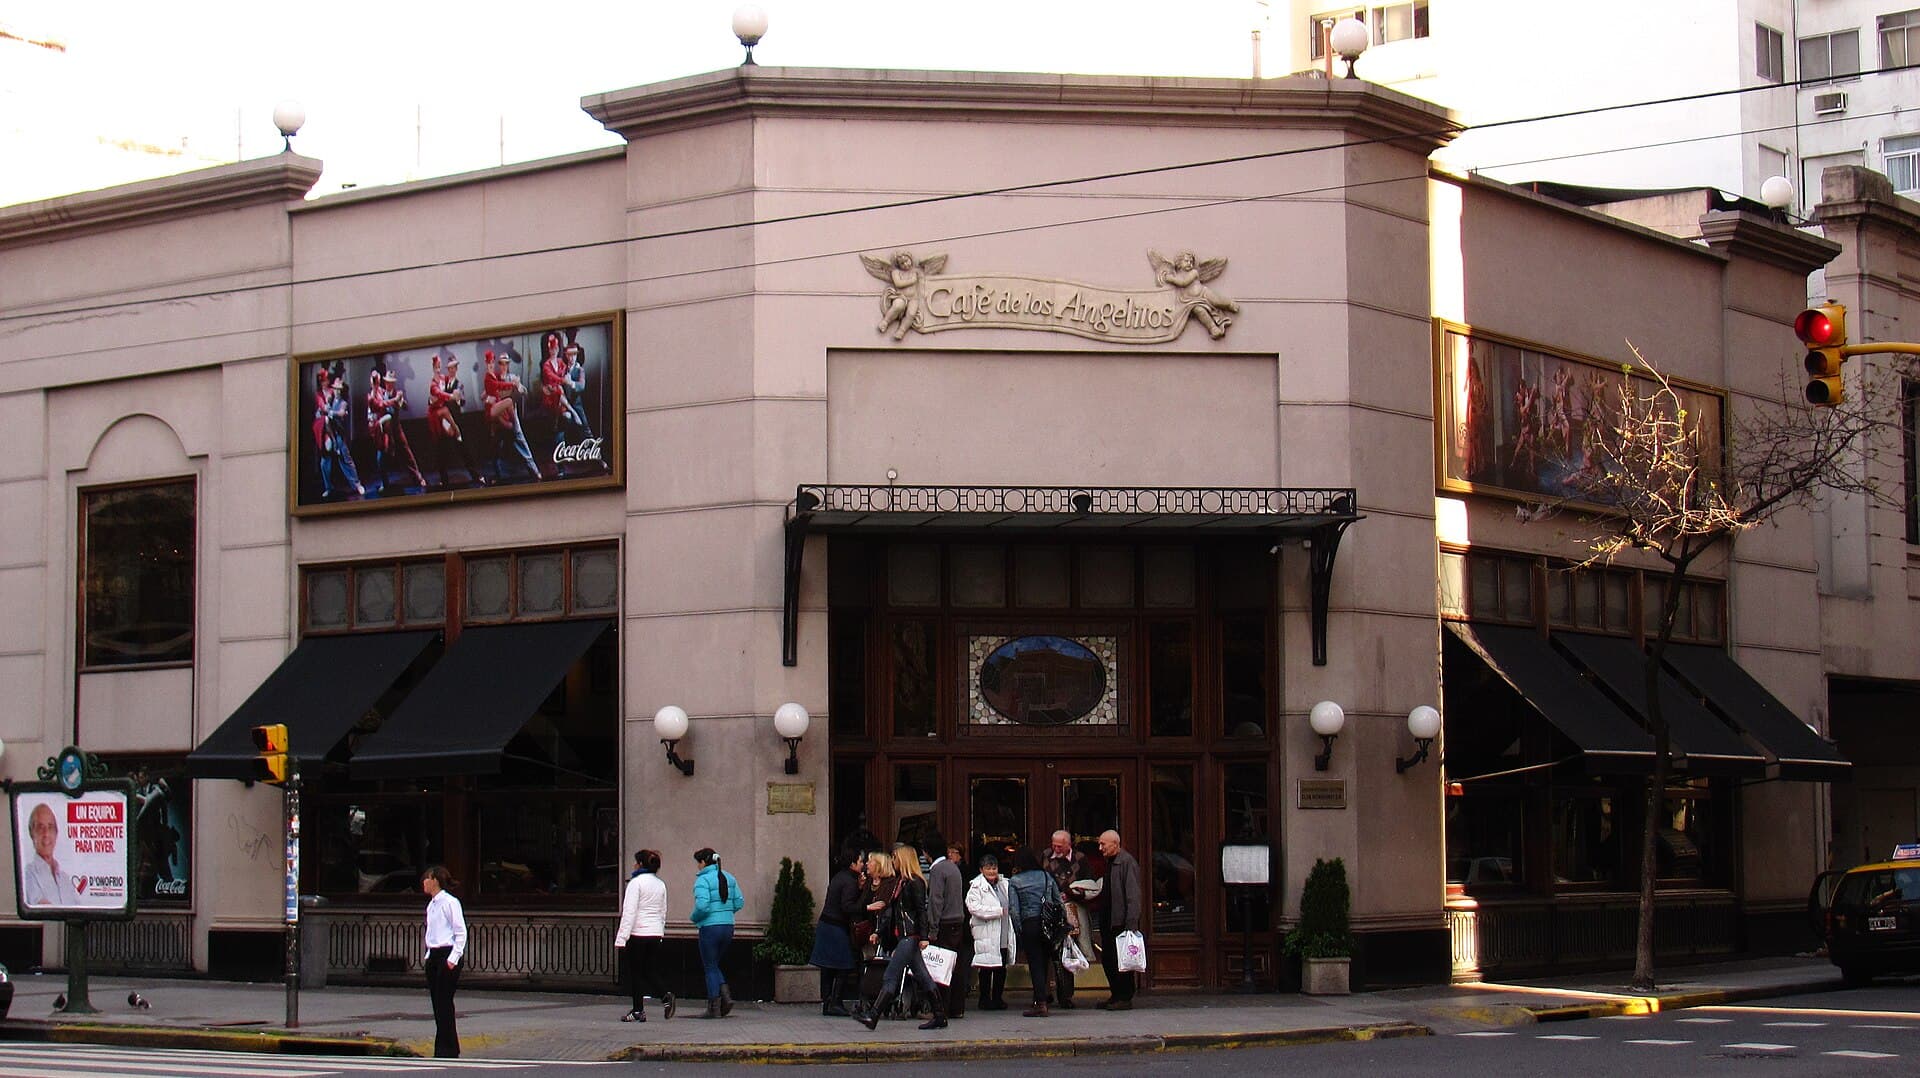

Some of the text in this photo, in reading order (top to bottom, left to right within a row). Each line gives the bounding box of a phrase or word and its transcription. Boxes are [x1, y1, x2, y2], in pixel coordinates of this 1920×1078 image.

[926, 285, 1174, 333] Café de los Angelitos
[553, 438, 603, 463] Coca-Cola
[75, 805, 117, 821] UN EQUIPO.
[67, 825, 123, 838] UN PRESIDENTE
[75, 840, 116, 853] PARA RIVER.
[89, 876, 124, 887] D'ONOFRIO
